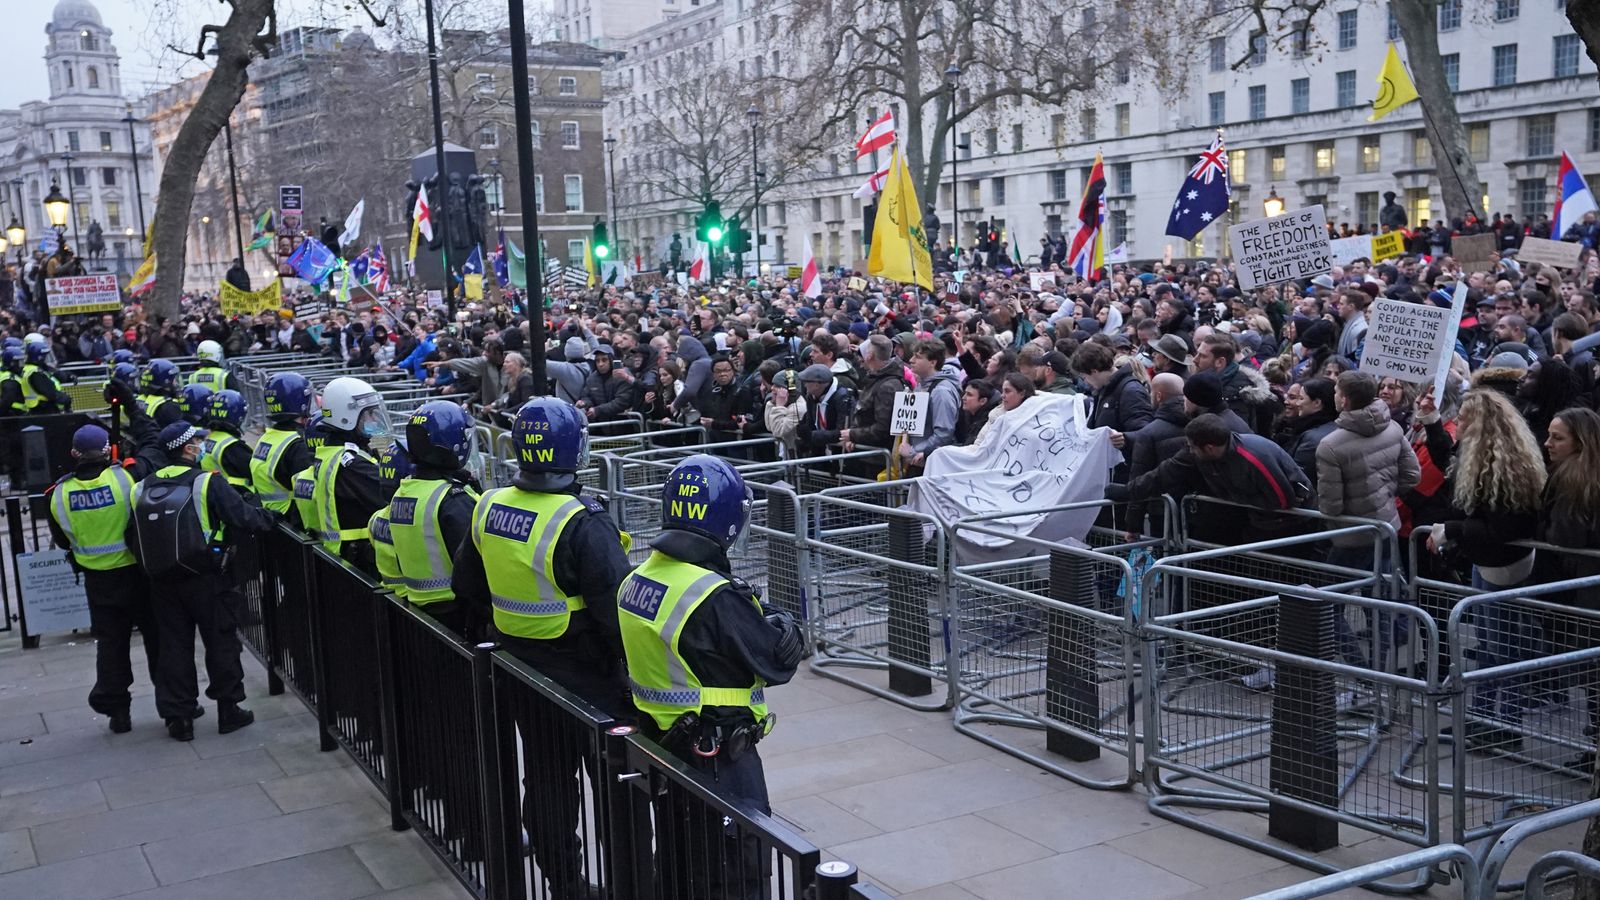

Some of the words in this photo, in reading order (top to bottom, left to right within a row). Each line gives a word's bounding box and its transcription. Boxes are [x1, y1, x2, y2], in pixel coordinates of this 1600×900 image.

[1239, 226, 1260, 239] THE
[1268, 216, 1296, 231] PRICE
[1300, 212, 1312, 223] OF
[1242, 224, 1322, 255] FREEDOM:
[1239, 249, 1285, 266] CONSTANT
[1248, 263, 1262, 271] THE
[1252, 264, 1292, 284] FIGHT
[1297, 255, 1331, 274] BACK
[947, 281, 960, 294] NO
[1376, 302, 1406, 313] COVID
[1378, 313, 1417, 327] REDUCE
[1421, 320, 1440, 331] THE
[1377, 323, 1436, 340] POPULATION
[1373, 334, 1391, 343] AND
[1393, 337, 1435, 351] CONTROL
[1382, 344, 1400, 356] THE
[1403, 347, 1429, 360] REST
[1365, 356, 1380, 367] NO
[1386, 360, 1407, 372] GMO
[1409, 364, 1428, 376] VAX
[903, 393, 916, 407] NO
[897, 408, 918, 420] COVID
[520, 421, 549, 430] 3732
[525, 433, 543, 444] MP
[678, 473, 708, 484] 3673
[70, 489, 114, 509] POLICE
[678, 484, 700, 497] MP
[487, 508, 533, 537] POLICE
[621, 579, 663, 615] POLICE
